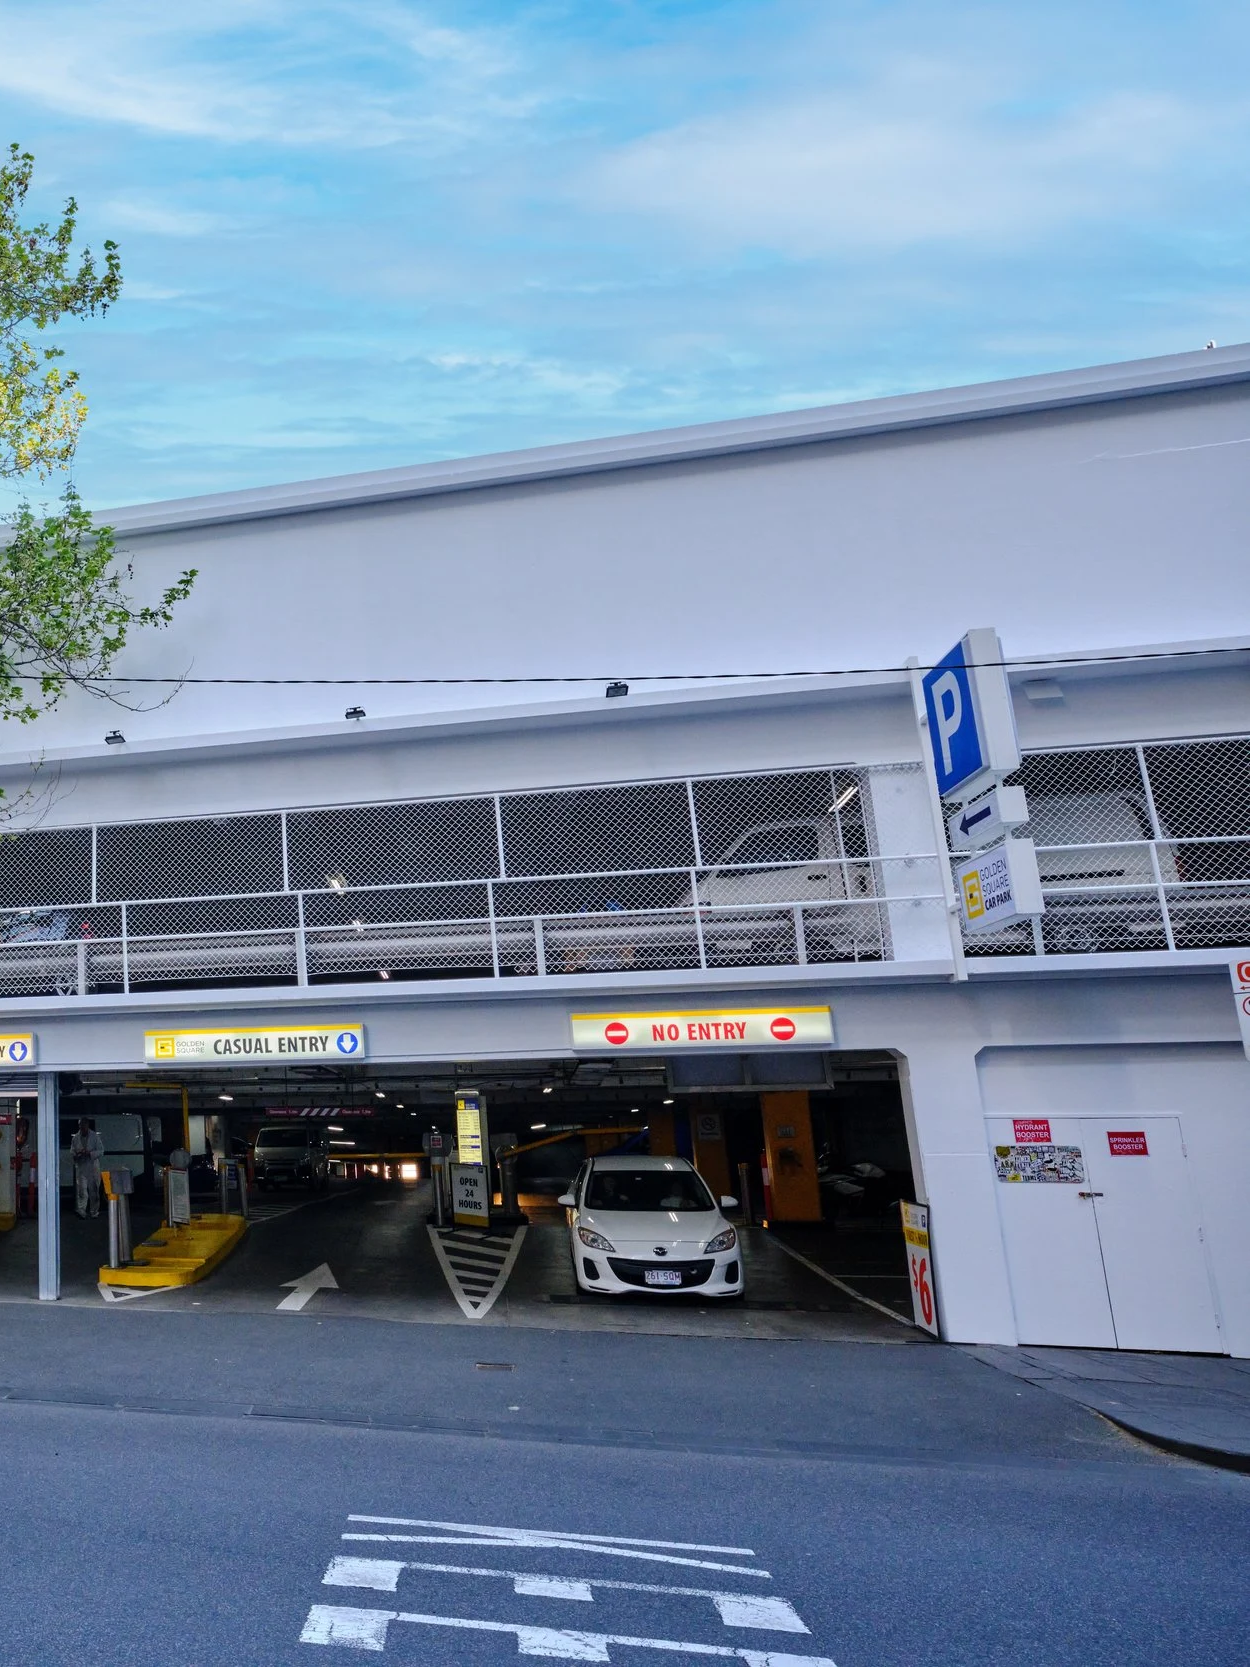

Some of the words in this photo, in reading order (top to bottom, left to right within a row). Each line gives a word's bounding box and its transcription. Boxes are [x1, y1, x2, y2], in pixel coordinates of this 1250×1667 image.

[930, 670, 962, 776] P
[979, 857, 1007, 882] GOLDEN
[981, 873, 1010, 896] SQUARE
[984, 894, 998, 912] CAR
[996, 889, 1012, 908] PARK
[651, 1023, 680, 1042] NO
[687, 1020, 747, 1041] ENTRY
[176, 1040, 205, 1048] GOLDEN
[176, 1047, 205, 1055] SQUARE
[213, 1037, 272, 1055] CASUAL
[278, 1035, 329, 1053] ENTRY
[459, 1176, 479, 1187] OPEN
[465, 1189, 474, 1198] 24
[458, 1199, 482, 1210] HOURS
[911, 1254, 933, 1326] $6
